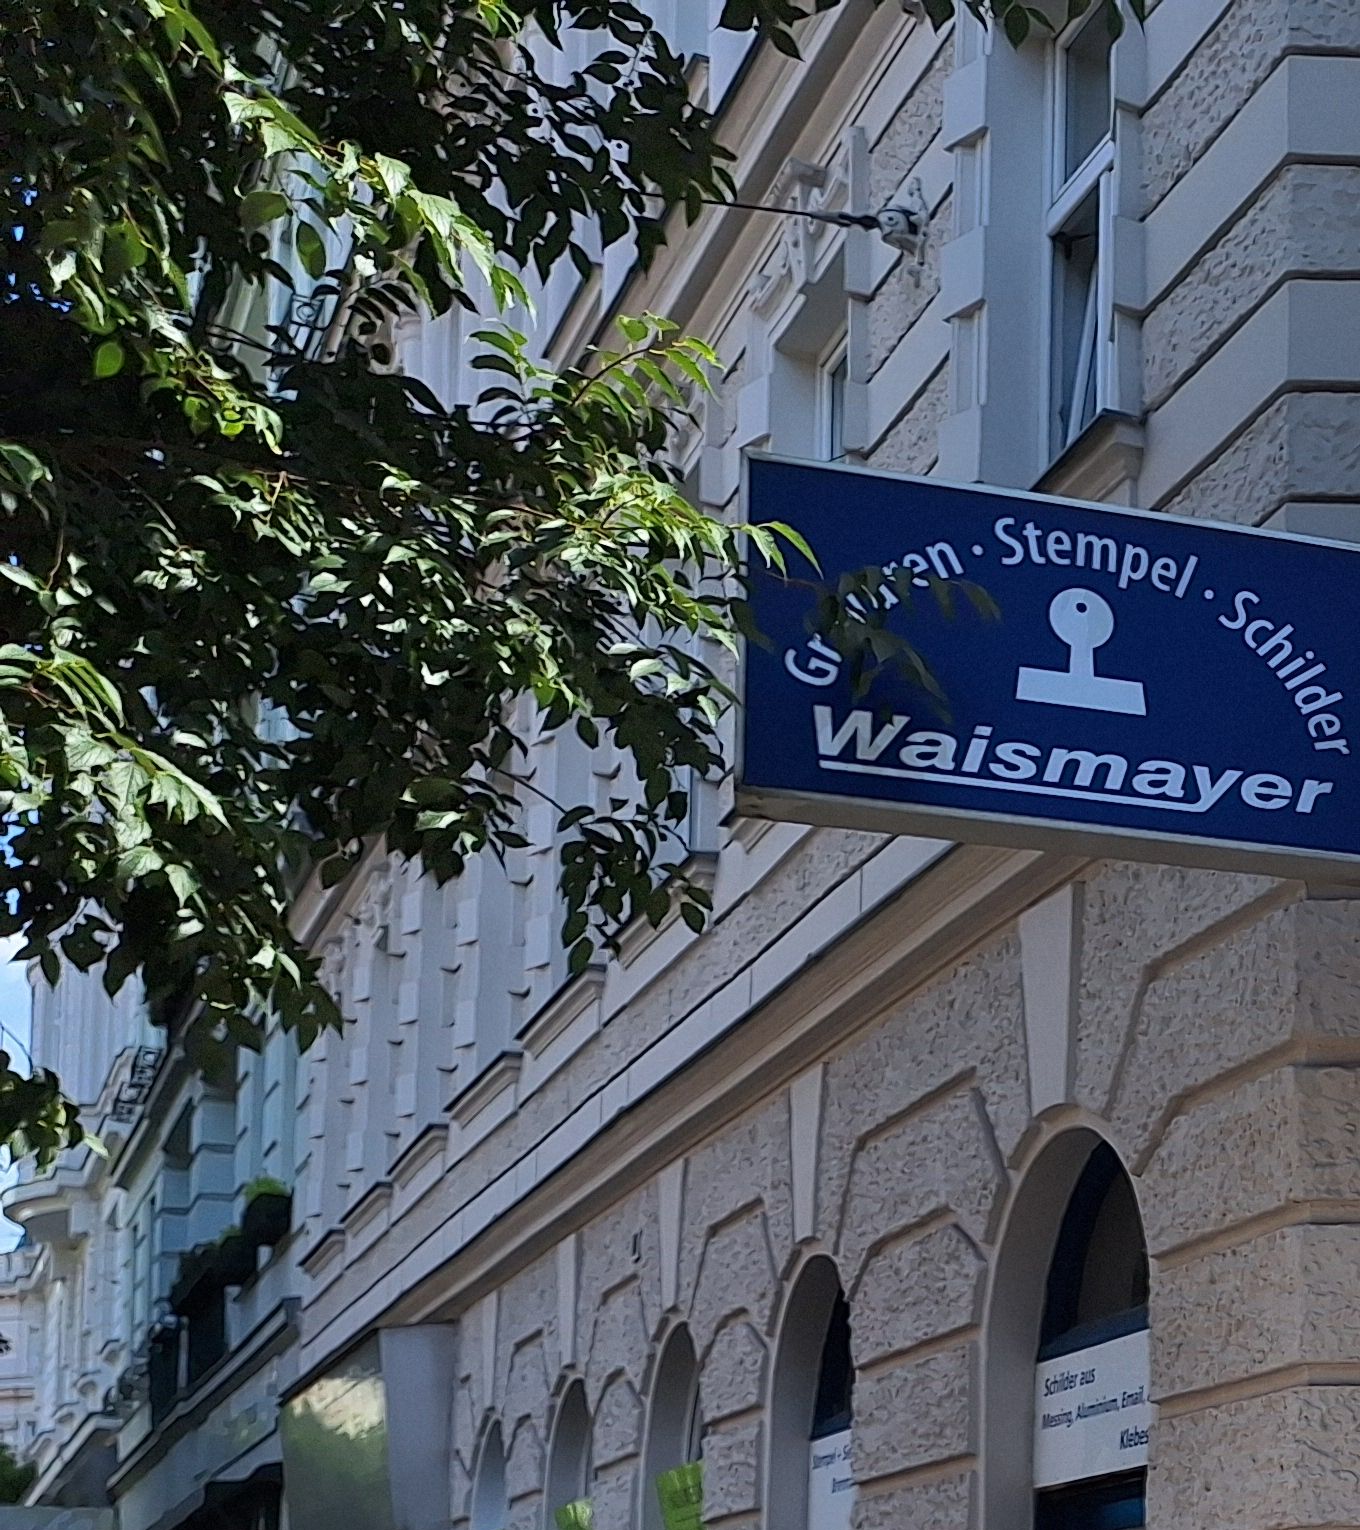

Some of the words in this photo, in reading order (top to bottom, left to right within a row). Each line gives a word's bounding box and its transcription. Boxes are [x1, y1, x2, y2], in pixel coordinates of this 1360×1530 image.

[994, 516, 1198, 599] Stempel
[1218, 589, 1351, 757] Schilder
[811, 703, 1334, 813] Waismayer
[1043, 1369, 1078, 1397] Schilder
[1079, 1367, 1096, 1387] aus
